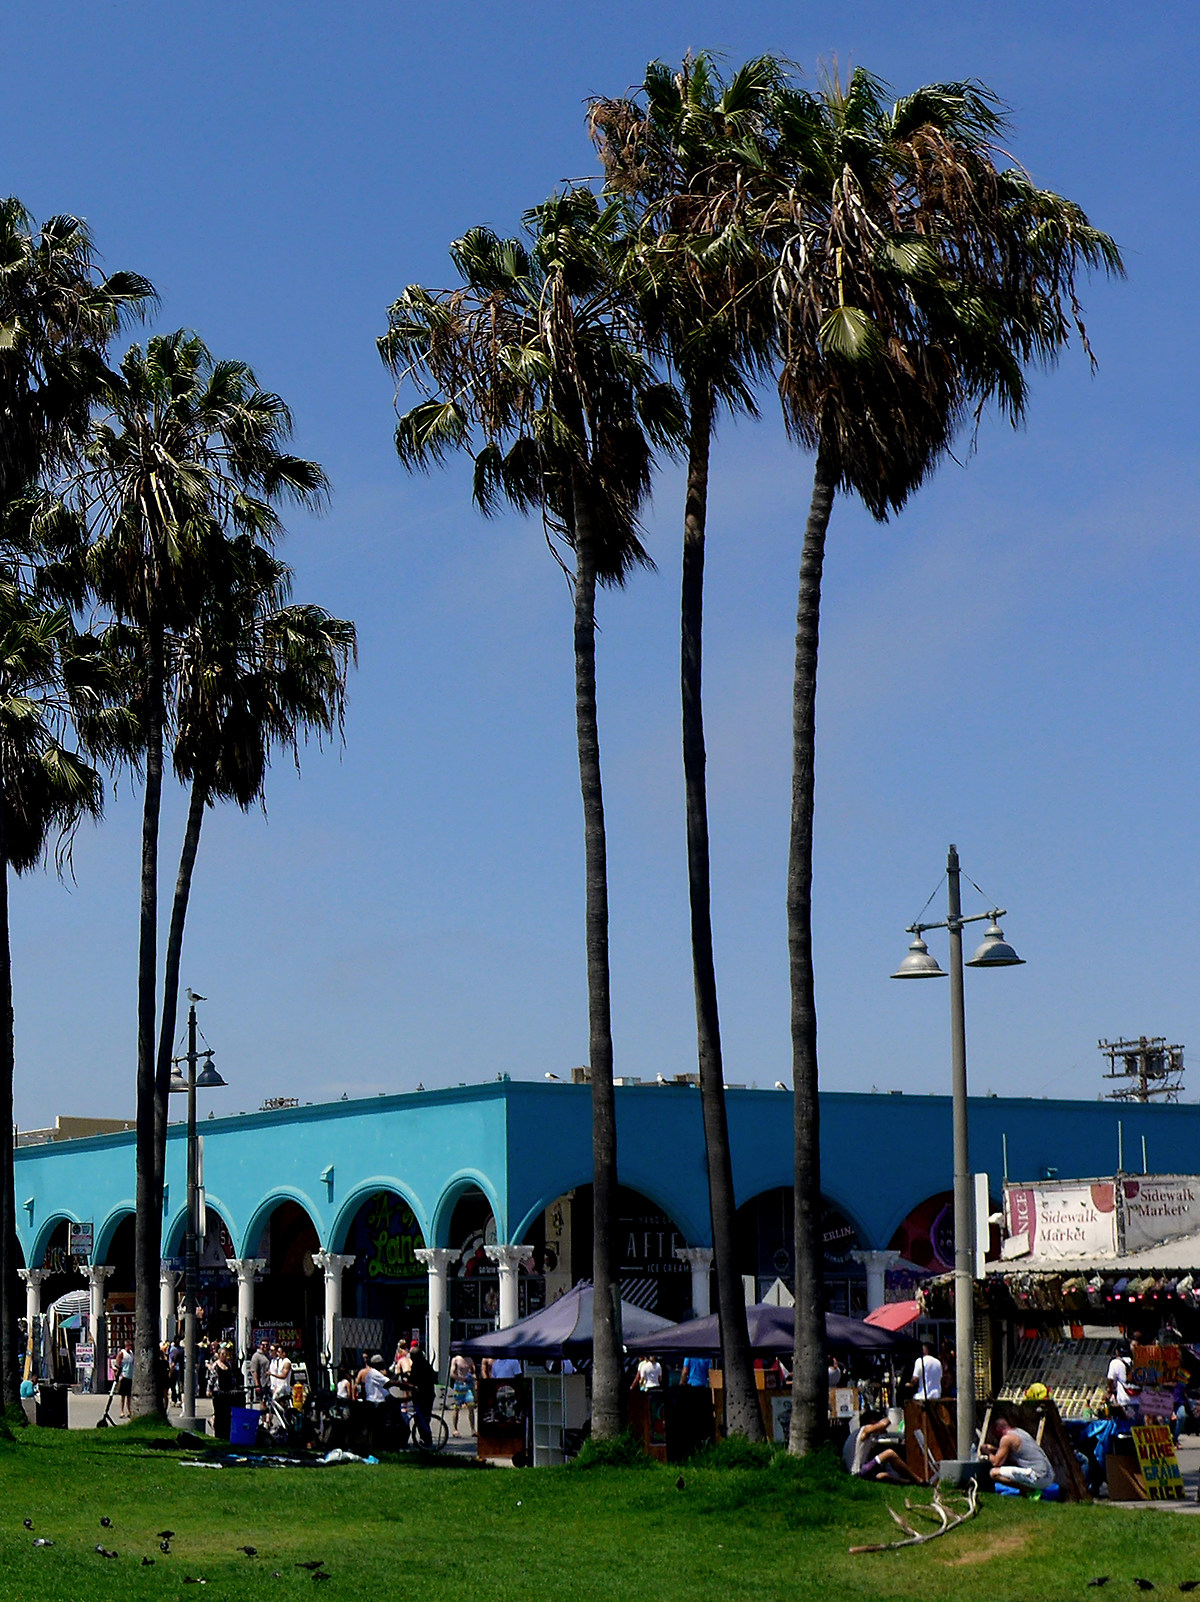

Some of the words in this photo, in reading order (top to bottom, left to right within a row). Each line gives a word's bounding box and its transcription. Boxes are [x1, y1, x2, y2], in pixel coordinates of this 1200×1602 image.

[1140, 1189, 1196, 1202] Sidewalk
[1040, 1210, 1098, 1224] Sidewalk
[1138, 1203, 1183, 1217] Market
[1040, 1228, 1086, 1242] Market
[647, 1263, 659, 1272] ICE
[663, 1263, 689, 1273] CREAM
[1134, 1427, 1170, 1443] YOUR
[1138, 1443, 1175, 1459] NAME
[1143, 1464, 1181, 1481] GRAIN
[1149, 1485, 1185, 1500] RICE
